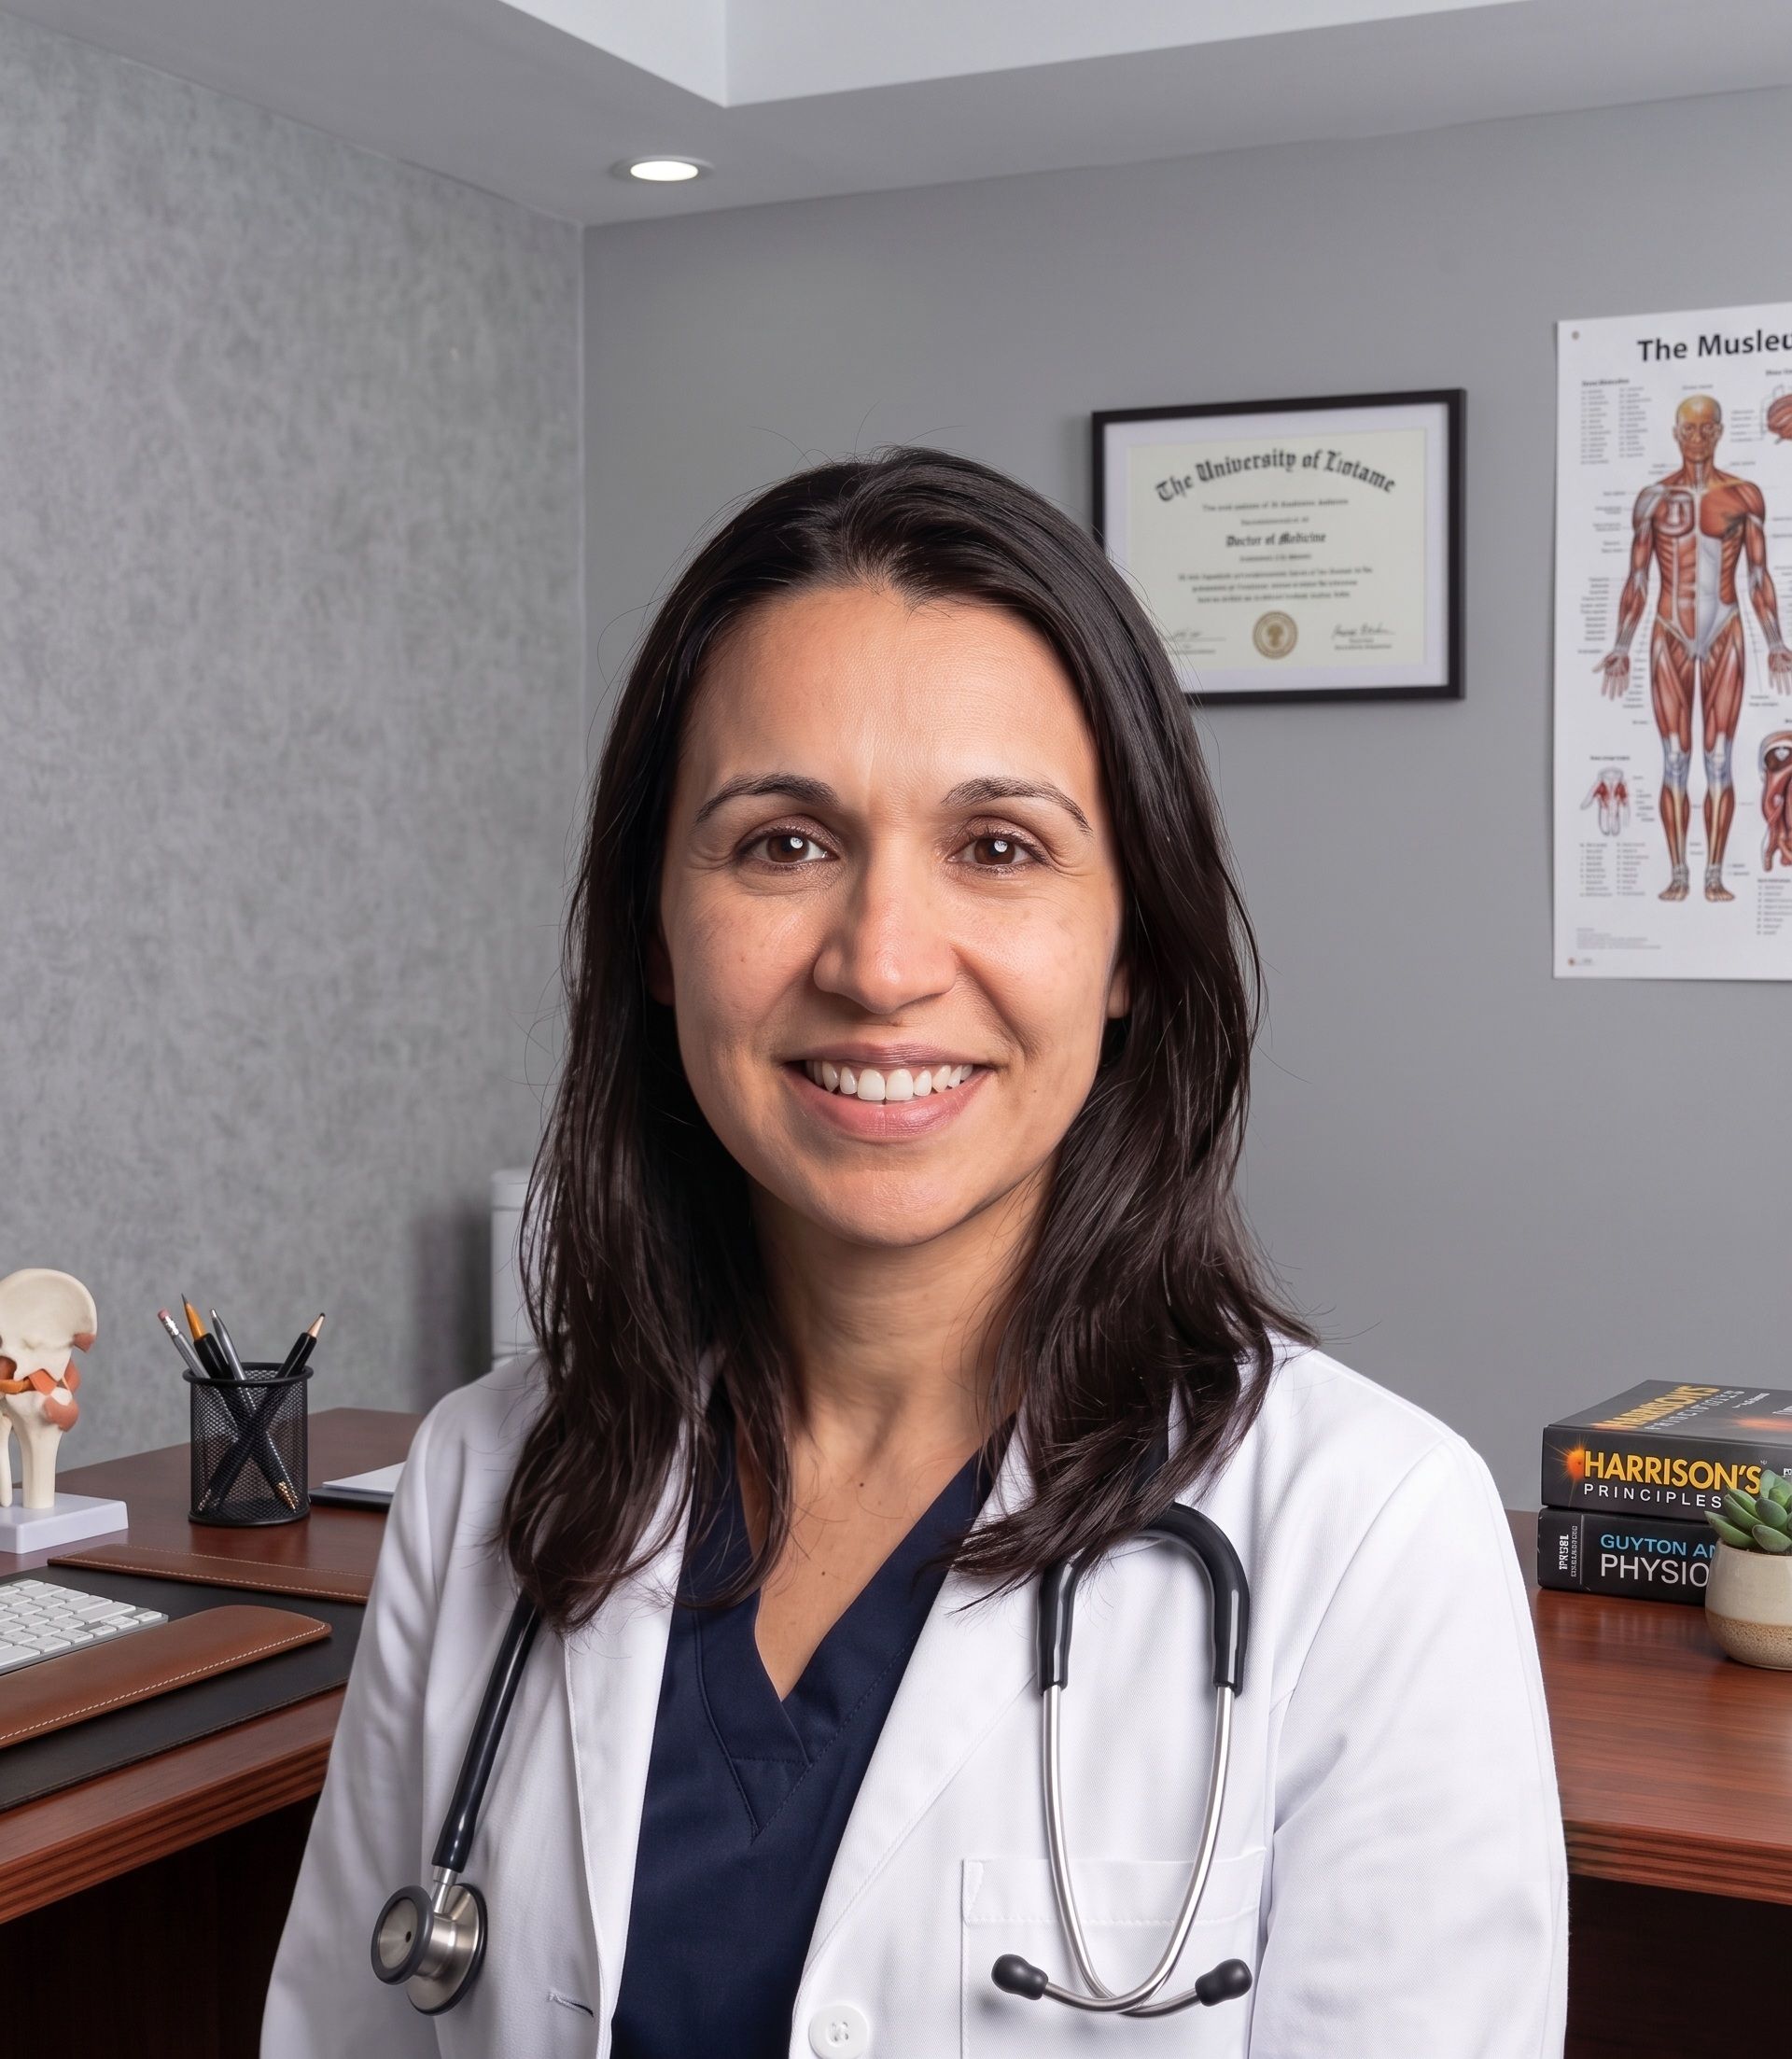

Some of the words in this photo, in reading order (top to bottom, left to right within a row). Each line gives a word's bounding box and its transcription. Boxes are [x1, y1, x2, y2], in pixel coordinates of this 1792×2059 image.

[1638, 338, 1687, 361] The
[1155, 473, 1194, 502] The
[1195, 448, 1296, 483] University
[1302, 449, 1323, 469] of
[1584, 1450, 1761, 1494] HARRISON'S
[1584, 1483, 1722, 1508] PRINCIPLES
[1601, 1534, 1687, 1557] GUYTON
[1601, 1553, 1710, 1588] PHYSIO
